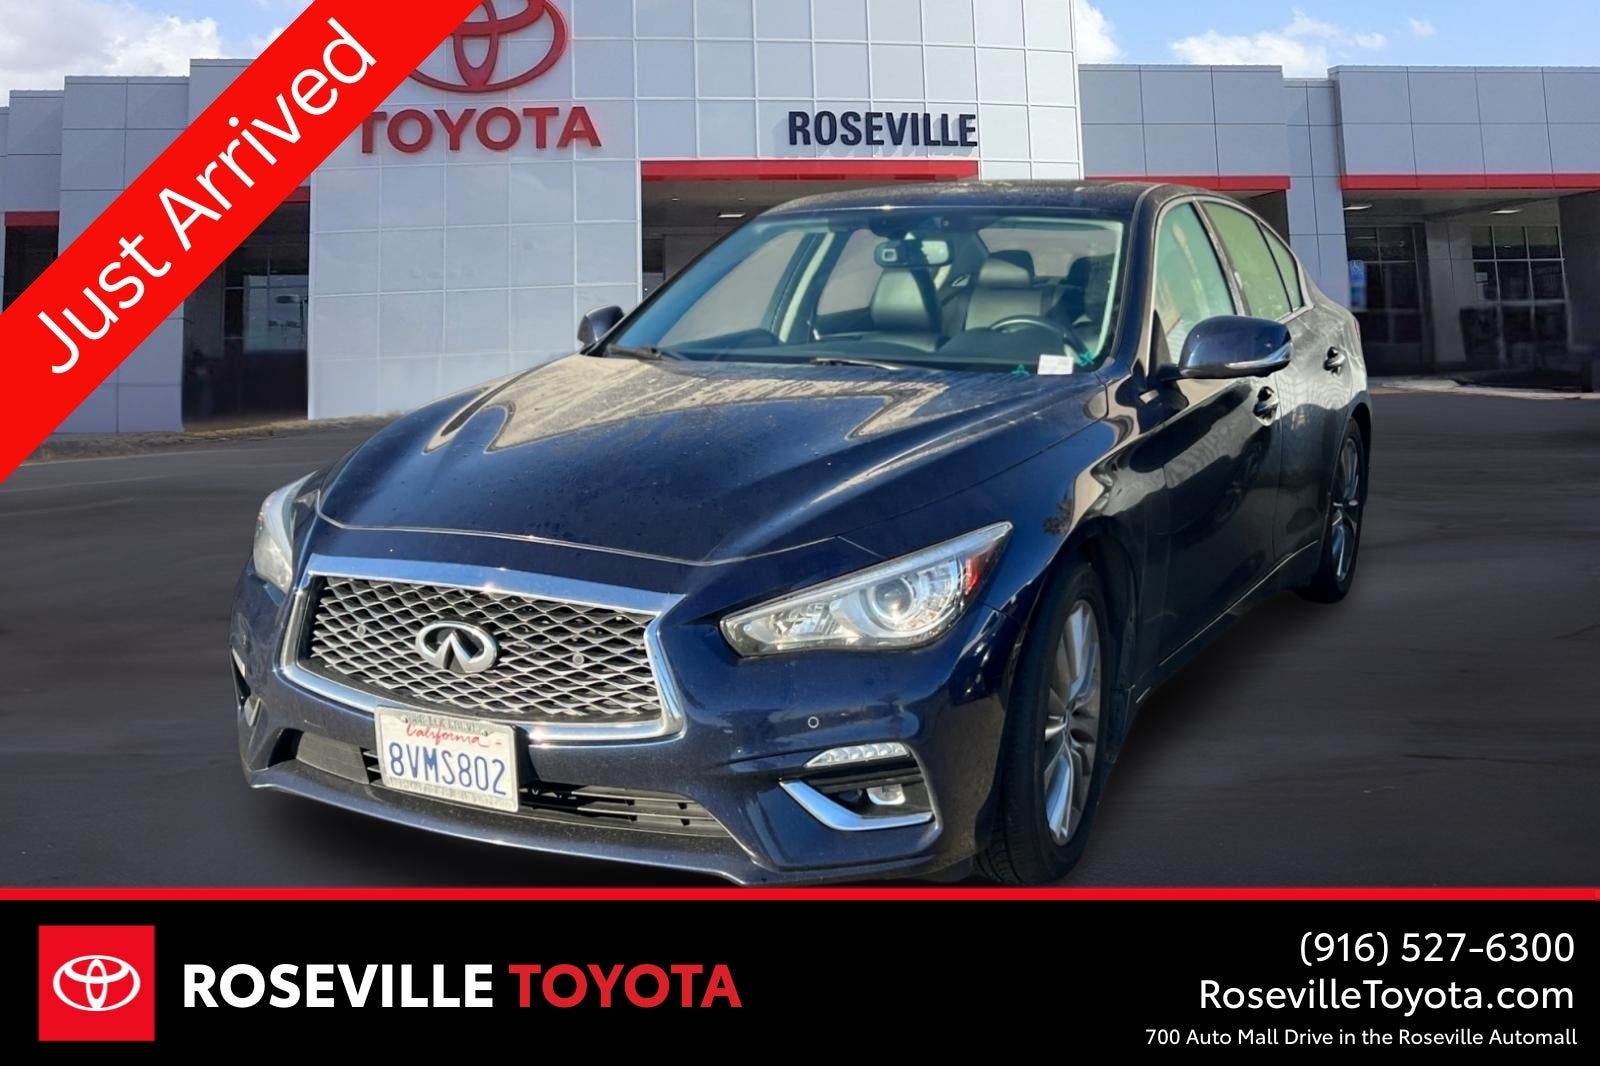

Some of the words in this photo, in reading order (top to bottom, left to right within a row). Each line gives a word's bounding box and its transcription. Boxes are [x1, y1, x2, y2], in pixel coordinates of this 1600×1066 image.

[361, 106, 602, 154] TOYOTA
[788, 110, 978, 147] ROSEVILLE
[406, 720, 489, 748] California
[388, 742, 507, 796] 8VMS802
